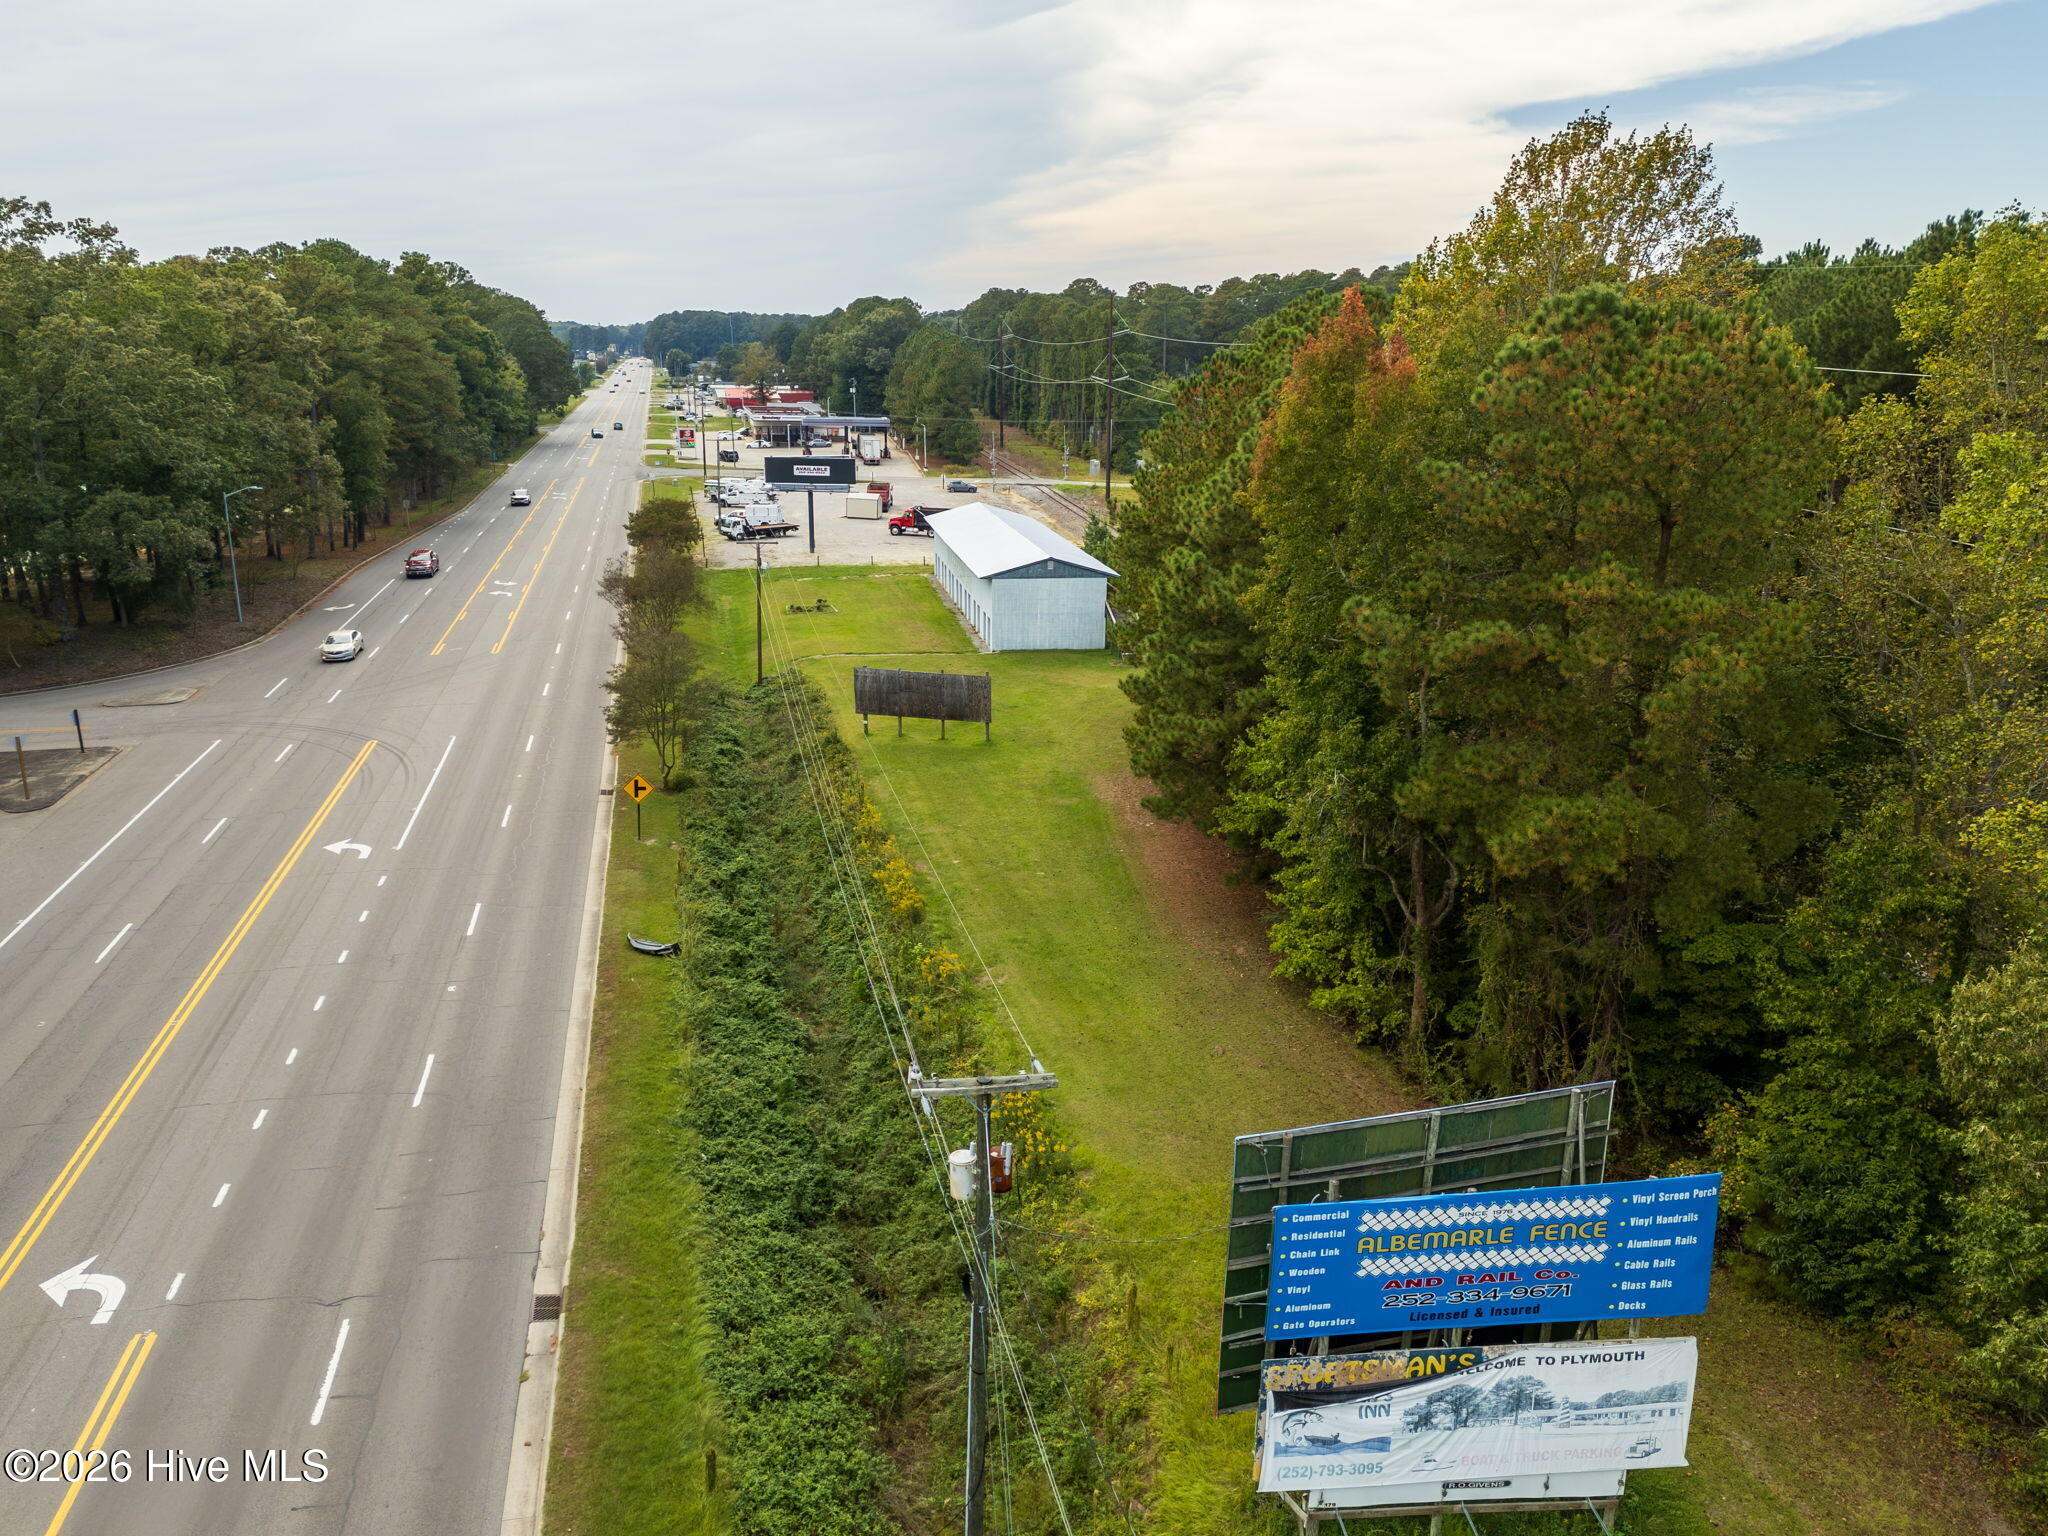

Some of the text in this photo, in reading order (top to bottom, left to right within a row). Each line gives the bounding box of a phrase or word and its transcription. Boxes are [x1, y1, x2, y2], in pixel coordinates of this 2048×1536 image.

[1632, 1187, 1717, 1204] Vinyl Screen Porch
[1292, 1210, 1350, 1222] Commercial
[1630, 1213, 1698, 1226] Vinyl Handrails
[1291, 1230, 1346, 1241] Residential
[1357, 1220, 1608, 1254] ALBEMARLE FENCE
[1627, 1236, 1698, 1248] Aluminum Rails
[1290, 1248, 1340, 1259] Chain Link
[1624, 1258, 1676, 1270] Cable Rails
[1289, 1268, 1326, 1276] Wooden
[1382, 1277, 1444, 1290] AND
[1457, 1272, 1522, 1286] RAIL
[1621, 1280, 1672, 1290] Glass Rails
[1287, 1286, 1310, 1295] Vinyl
[1382, 1283, 1572, 1308] 252-334-9671
[1284, 1303, 1331, 1312] Aluminum
[1618, 1302, 1646, 1310] Decks
[1410, 1304, 1540, 1322] Licensed & Insured
[1282, 1317, 1355, 1330] Gate Operators
[1536, 1356, 1555, 1366] TO
[1561, 1350, 1645, 1364] PLYMOUTH
[1358, 1404, 1390, 1419] INN
[1461, 1454, 1497, 1467] BOAT
[1515, 1451, 1560, 1462] TRUCK
[1564, 1447, 1622, 1460] PARKING
[1277, 1462, 1384, 1481] (252)-793-3095
